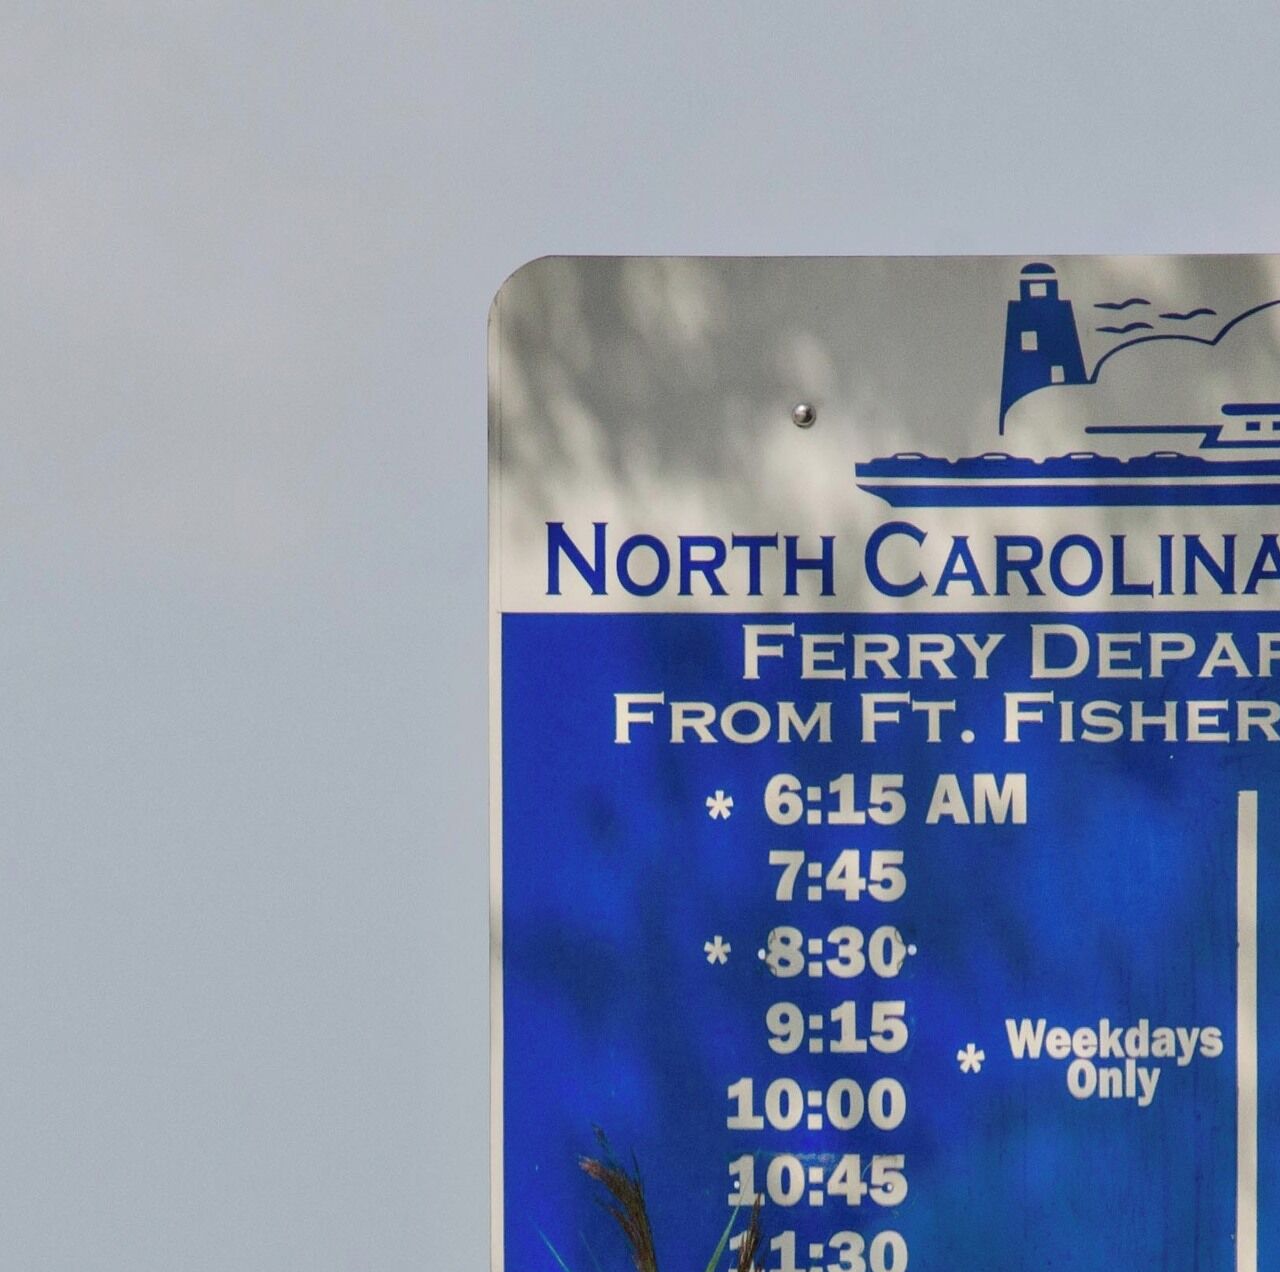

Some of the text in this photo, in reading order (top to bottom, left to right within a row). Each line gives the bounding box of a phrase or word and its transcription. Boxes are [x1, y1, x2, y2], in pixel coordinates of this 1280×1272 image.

[548, 523, 832, 597] NORTH
[742, 623, 1004, 681] FERRY
[613, 692, 831, 744] FROM
[860, 692, 975, 744] FT.
[1003, 690, 1280, 743] FISHER
[764, 773, 1028, 825] 6:15 AM
[768, 849, 906, 902] 7:45
[766, 926, 907, 977] 8:30
[766, 1000, 908, 1053] 9:15
[1006, 1018, 1224, 1066] Weekdays
[726, 1077, 907, 1130] 10:00
[1065, 1060, 1161, 1106] Only
[728, 1154, 908, 1206] 10:45
